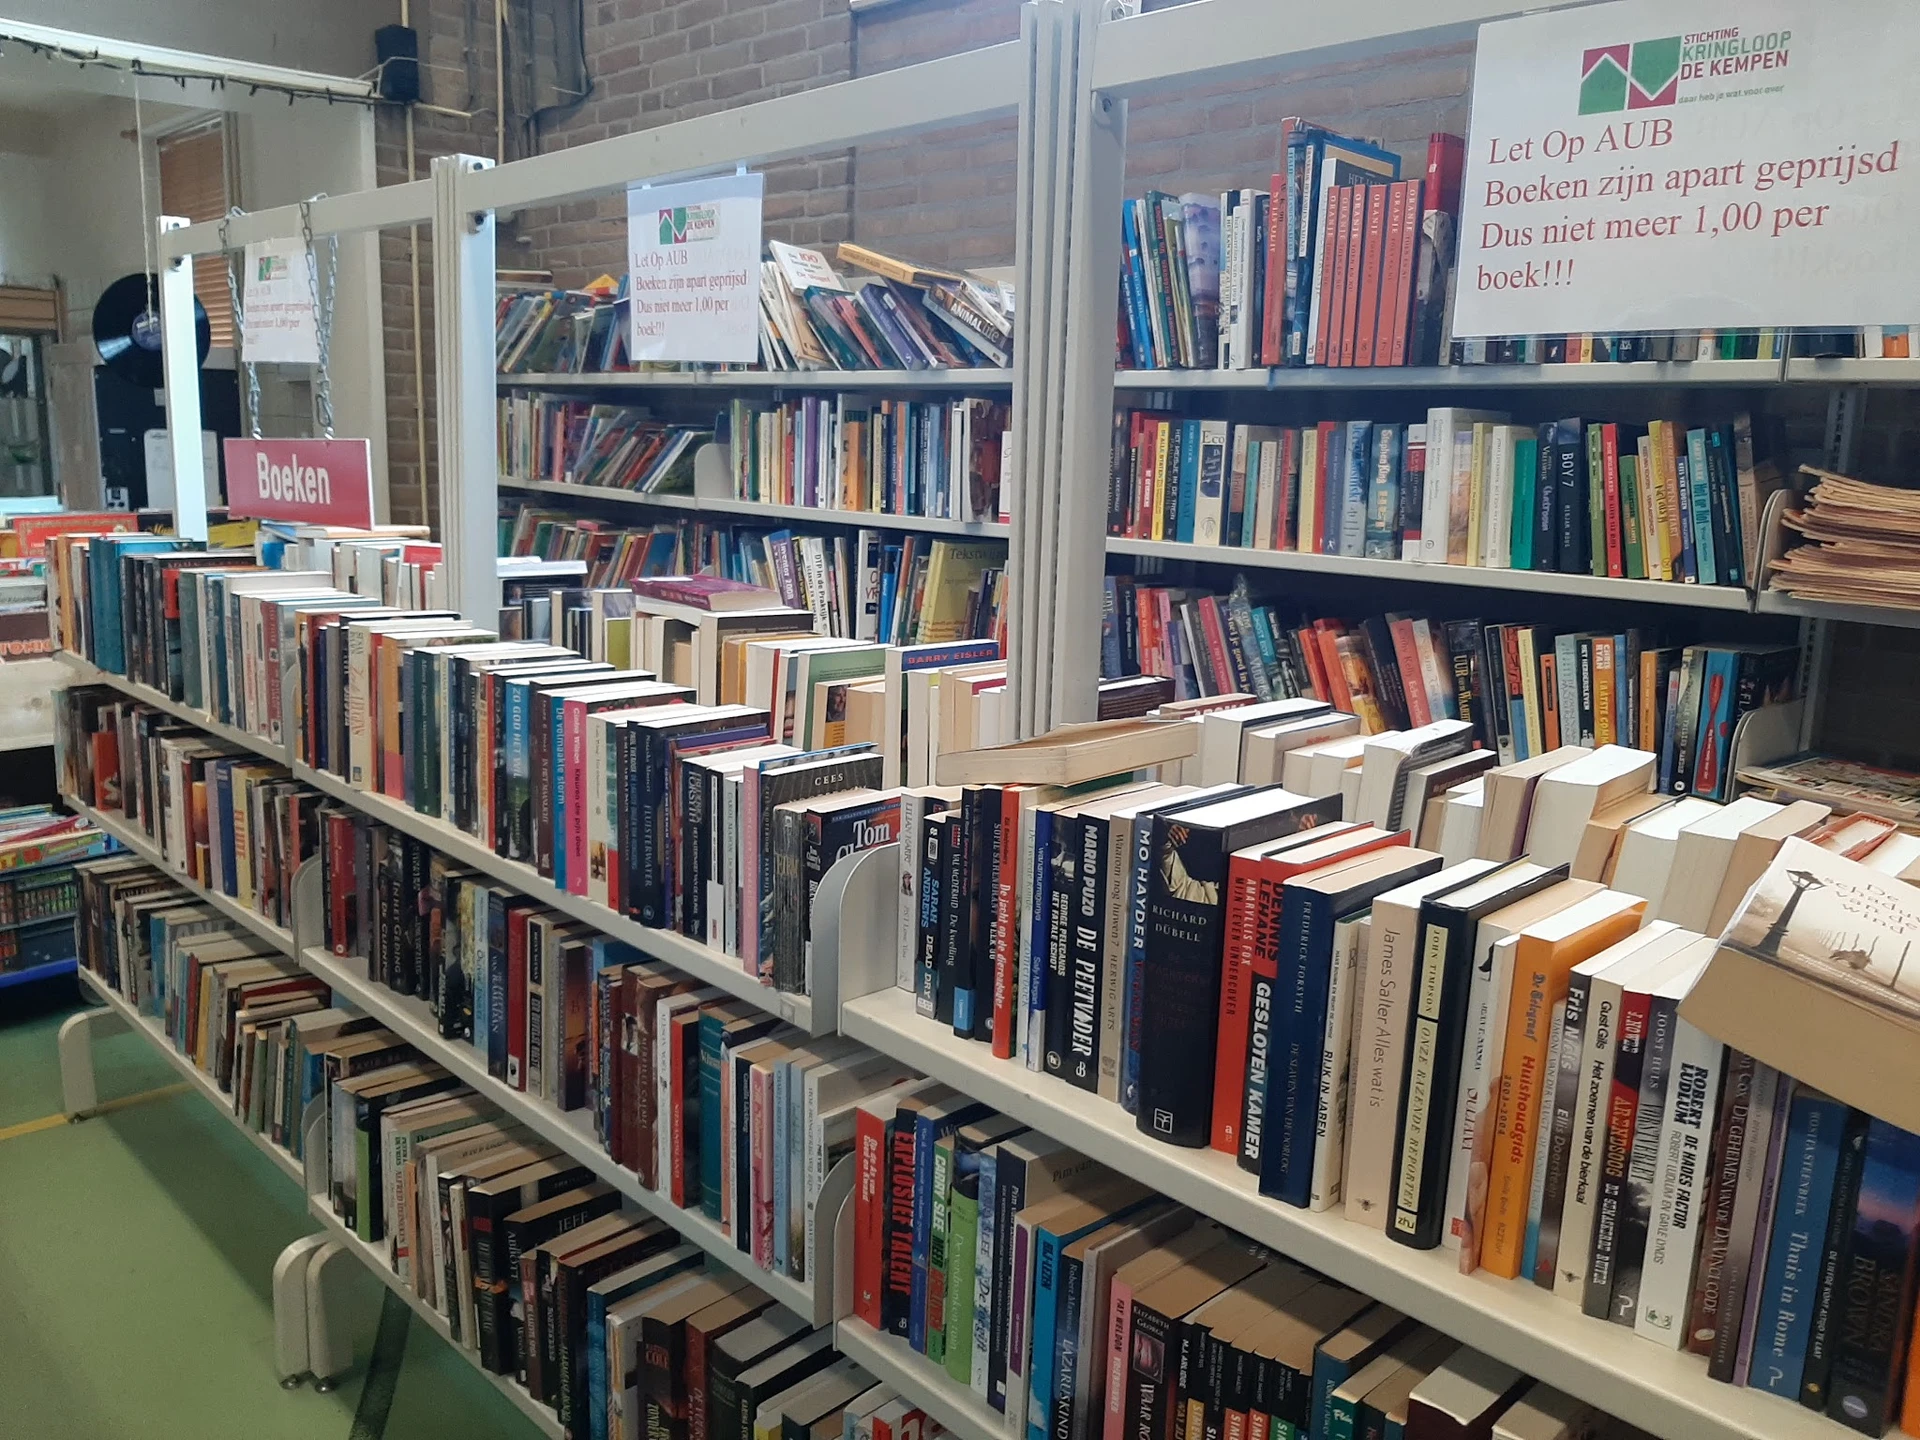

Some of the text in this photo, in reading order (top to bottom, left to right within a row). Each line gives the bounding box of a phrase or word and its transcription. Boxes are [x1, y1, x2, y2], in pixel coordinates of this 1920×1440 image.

[1683, 31, 1791, 62] KRINGLOOP
[1684, 27, 1738, 44] STICHTING
[1681, 50, 1789, 80] DE KEMPEN
[1679, 95, 1697, 103] daar
[1699, 93, 1714, 101] heb
[1489, 119, 1673, 164] Let Op AUB
[1484, 140, 1899, 206] Boeken zijn apart geprijsd
[1327, 196, 1336, 236] ORANJE
[1372, 194, 1380, 235] ORANJE
[1391, 192, 1401, 233] ORANJE
[1480, 202, 1830, 249] Dus niet meer 1,00 per
[634, 250, 687, 270] Let Op AUB
[1477, 259, 1574, 291] boek!!!
[636, 270, 747, 291] Boeken zijn apart geprijsd
[637, 297, 728, 315] Dus niet meer 1,00 per
[950, 302, 983, 335] ANIMAL
[1202, 429, 1225, 445] Eco
[1376, 429, 1392, 484] Stephen King
[256, 452, 330, 504] Boeken
[1173, 476, 1178, 484] IN
[1561, 452, 1574, 476] BOY
[1172, 486, 1177, 497] DE
[818, 580, 823, 588] de
[818, 591, 828, 621] Praktijk
[1252, 614, 1269, 656] GHOST BOY
[908, 650, 994, 663] BARRY EISLER
[1603, 644, 1611, 669] CHRIS
[1595, 644, 1603, 669] RYAN
[1599, 680, 1609, 714] LAATSTE
[556, 708, 565, 804] De volmaakte storm
[815, 773, 844, 786] CEES
[853, 819, 890, 849] Tom
[930, 879, 940, 924] SARAH
[1867, 884, 1899, 901] De
[921, 867, 933, 999] ANDREWS DEAD DRY
[1049, 890, 1060, 971] HET FATALE SCHOT
[1057, 893, 1069, 977] GEORGE PELECANOS
[1151, 904, 1208, 927] RICHARD
[1154, 922, 1201, 943] DÜBELL
[1241, 878, 1256, 966] AMARYLLIS FOX
[1267, 882, 1285, 962] DENNIS
[1842, 903, 1904, 934] wind
[1071, 824, 1099, 1057] MARIO PUZO DE PEETVADER
[1424, 929, 1441, 1014] JOHN TIMPSON
[1244, 878, 1272, 1160] LEHANE GESLOTEN KAMER
[1369, 928, 1400, 1107] James Salter Alles wat is
[1510, 972, 1547, 1166] De Telegraaf Huishoudgids
[1540, 1018, 1562, 1132] SIMONE VAN DER VLUGT
[1734, 1073, 1750, 1098] Cox
[1316, 1050, 1334, 1138] RIJK IN JAREN
[1575, 1000, 1613, 1204] Gust Gils Het zoemen van de bierkaai
[1673, 1062, 1695, 1126] LUDLUM
[1693, 1067, 1709, 1129] ROBERT
[1732, 1104, 1750, 1124] DE
[1402, 1027, 1431, 1209] ONZE RAZENDE REPORTER
[862, 1135, 871, 1201] Goed en Kwaad
[869, 1139, 878, 1195] Op de As van
[1720, 1125, 1743, 1187] GEHEIMEN
[1672, 1134, 1698, 1230] DE HADES FACTOR
[1718, 1187, 1735, 1208] VAN
[558, 1211, 589, 1233] JEFF
[889, 1131, 915, 1296] EXPLOSIEF TALENT
[1718, 1209, 1729, 1224] DE
[1712, 1226, 1730, 1245] DA
[1708, 1246, 1726, 1280] VINCI
[1133, 1306, 1170, 1330] ELIZABETH
[1703, 1282, 1722, 1316] CODE
[1137, 1318, 1165, 1337] GEORGE
[1056, 1338, 1074, 1440] LAZARUSKIND
